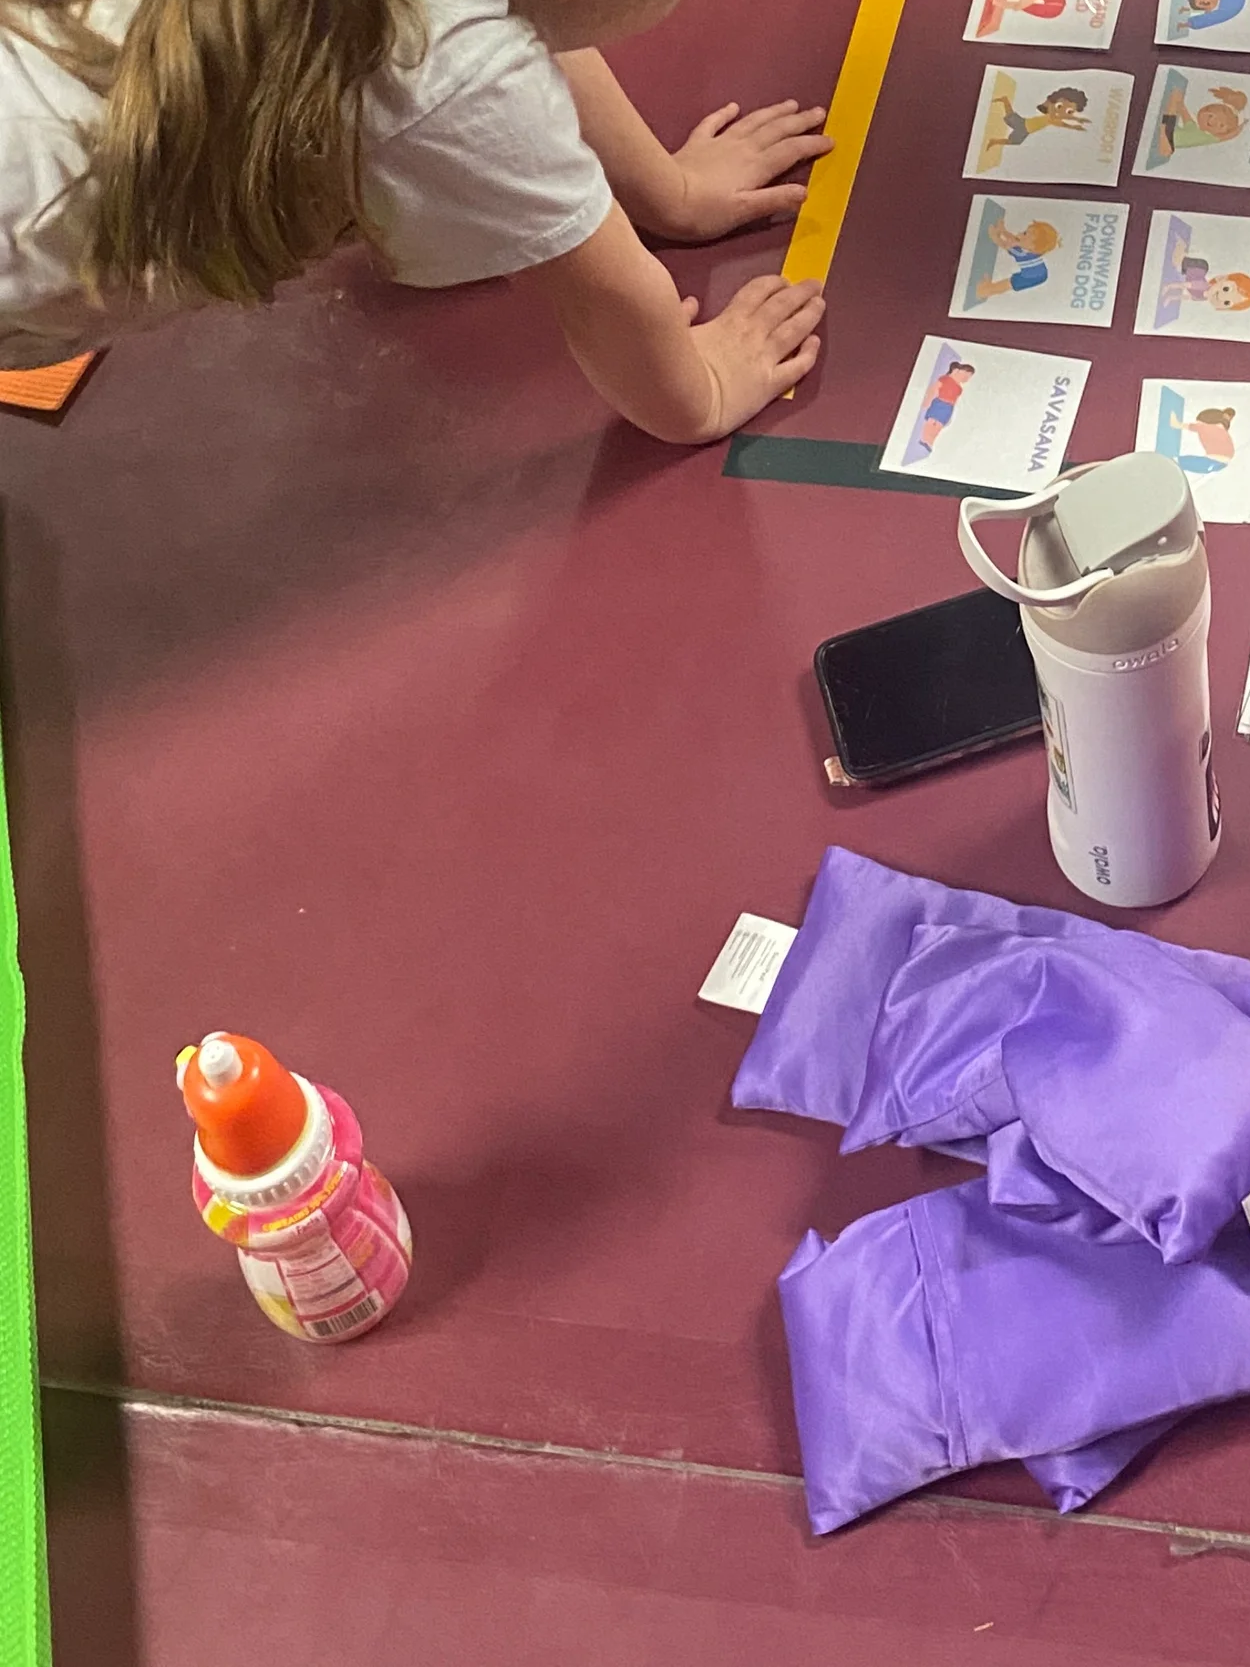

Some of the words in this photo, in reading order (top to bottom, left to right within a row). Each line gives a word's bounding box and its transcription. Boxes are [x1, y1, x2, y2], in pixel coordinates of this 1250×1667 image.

[1076, 213, 1101, 271] FACING
[1089, 214, 1119, 311] DOWNWARD
[1070, 274, 1091, 309] DOG
[1027, 375, 1071, 473] SAVASANA
[1112, 637, 1180, 672] owala
[1089, 845, 1112, 886] owala
